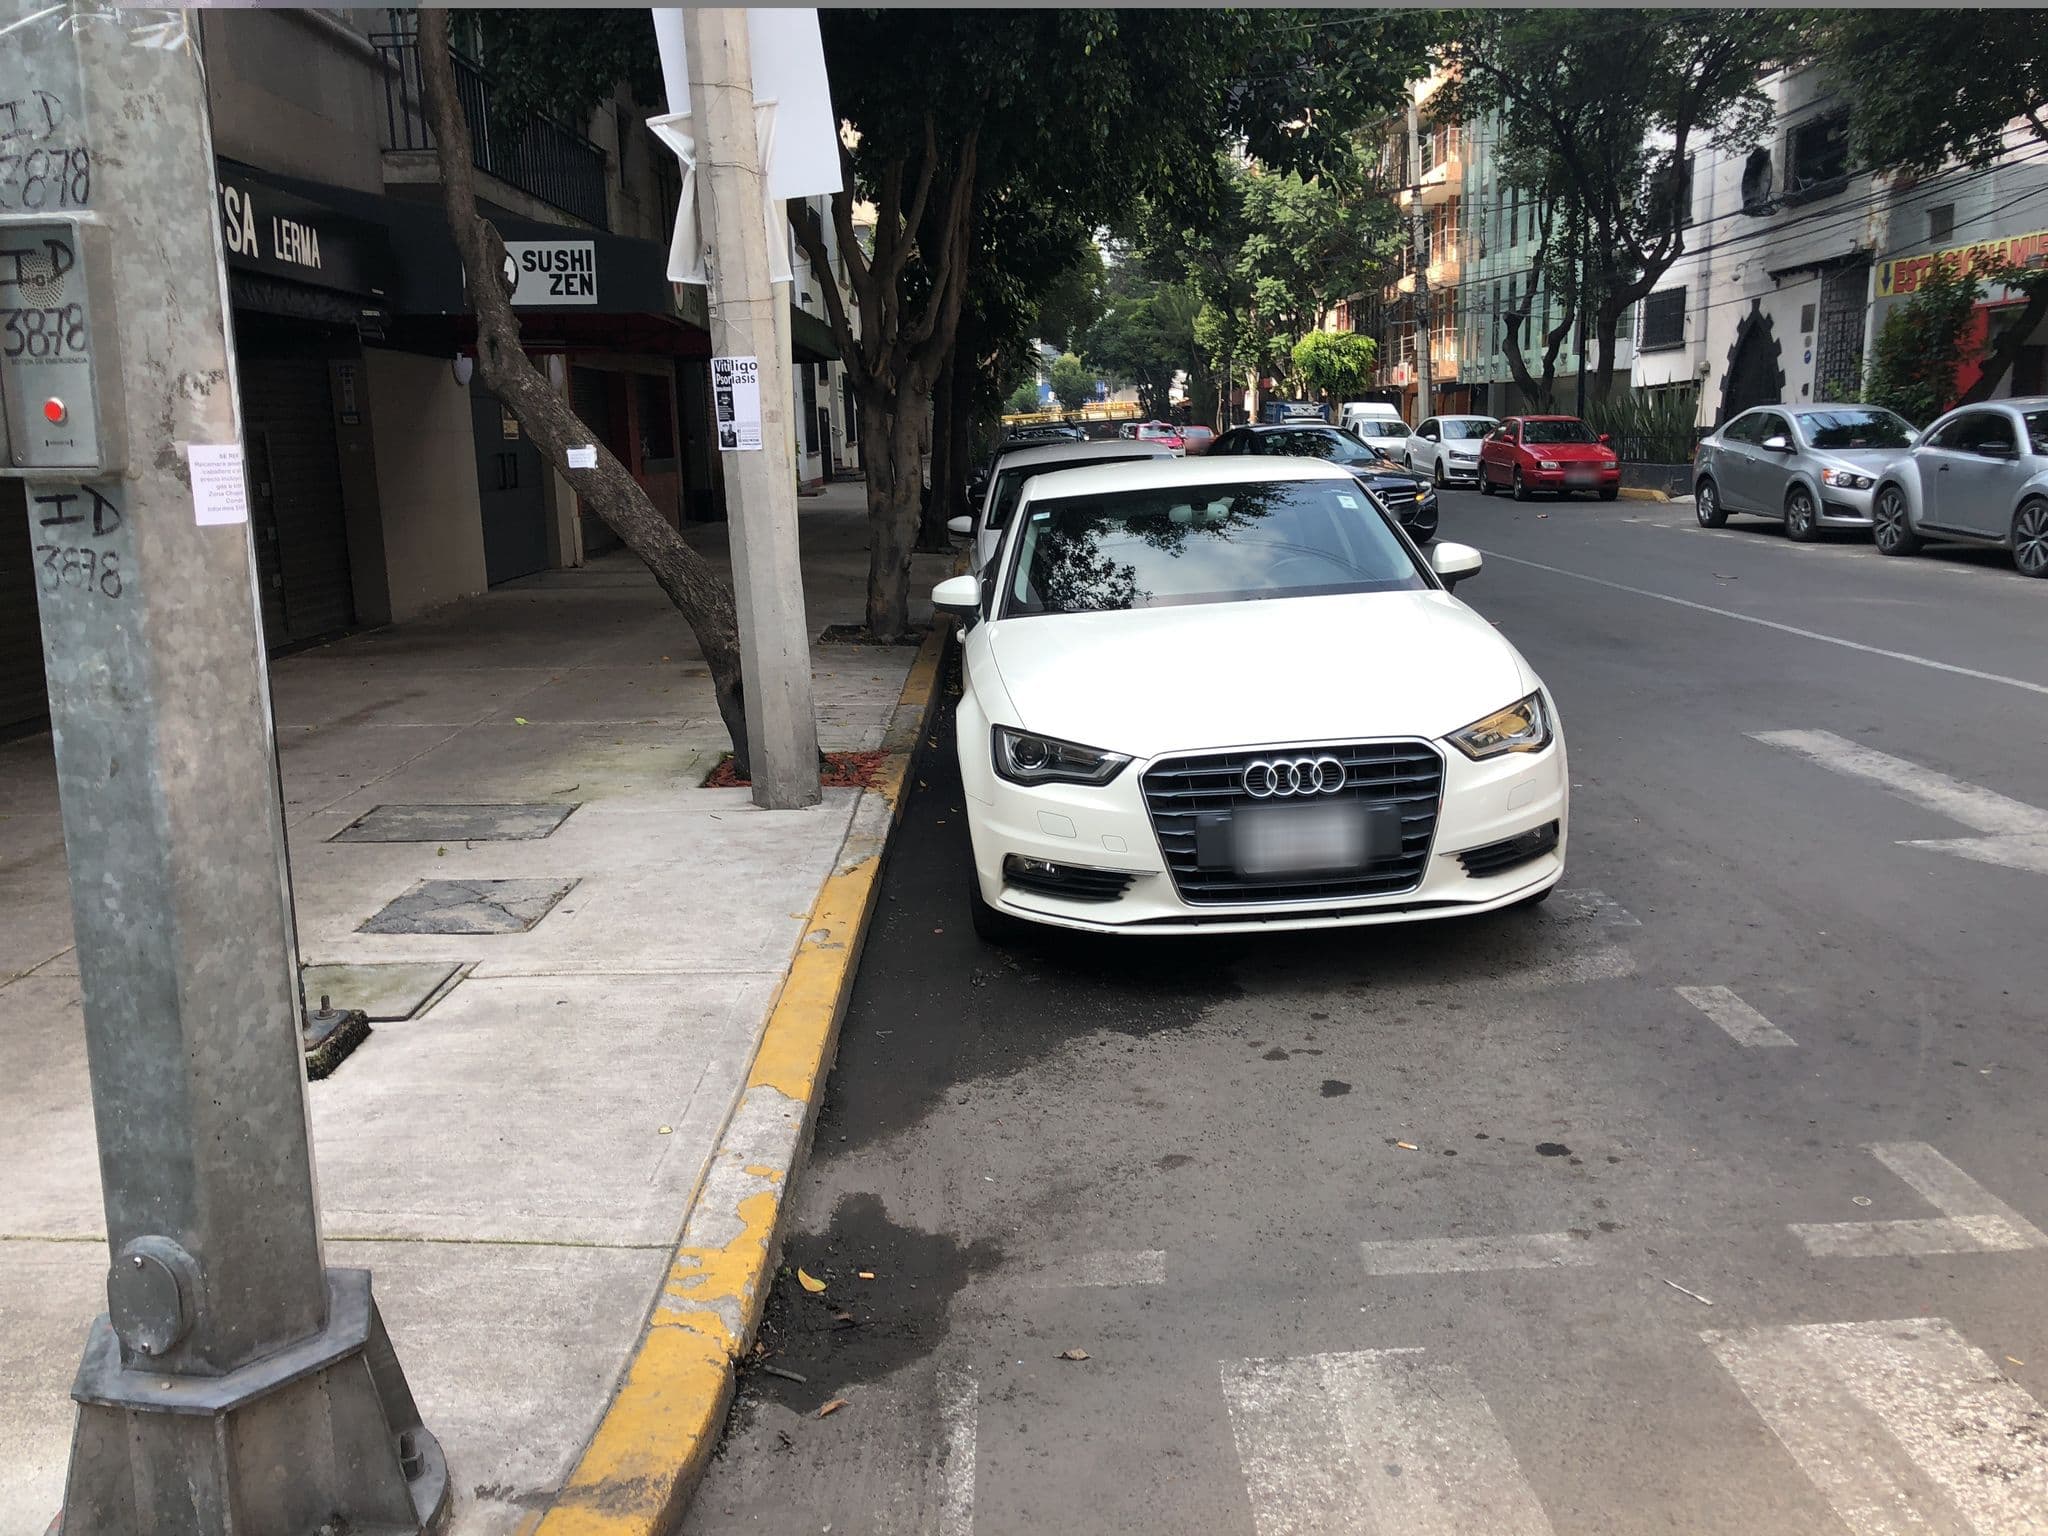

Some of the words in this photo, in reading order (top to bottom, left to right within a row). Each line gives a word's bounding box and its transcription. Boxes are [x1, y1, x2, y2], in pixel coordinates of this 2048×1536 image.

[219, 183, 259, 259] SA
[272, 216, 322, 270] LERMA
[522, 249, 593, 273] SUSHI
[549, 273, 594, 296] ZEN
[0, 303, 86, 357] 3878
[714, 359, 758, 374] Vitiligo
[716, 373, 756, 385] Psoriasis
